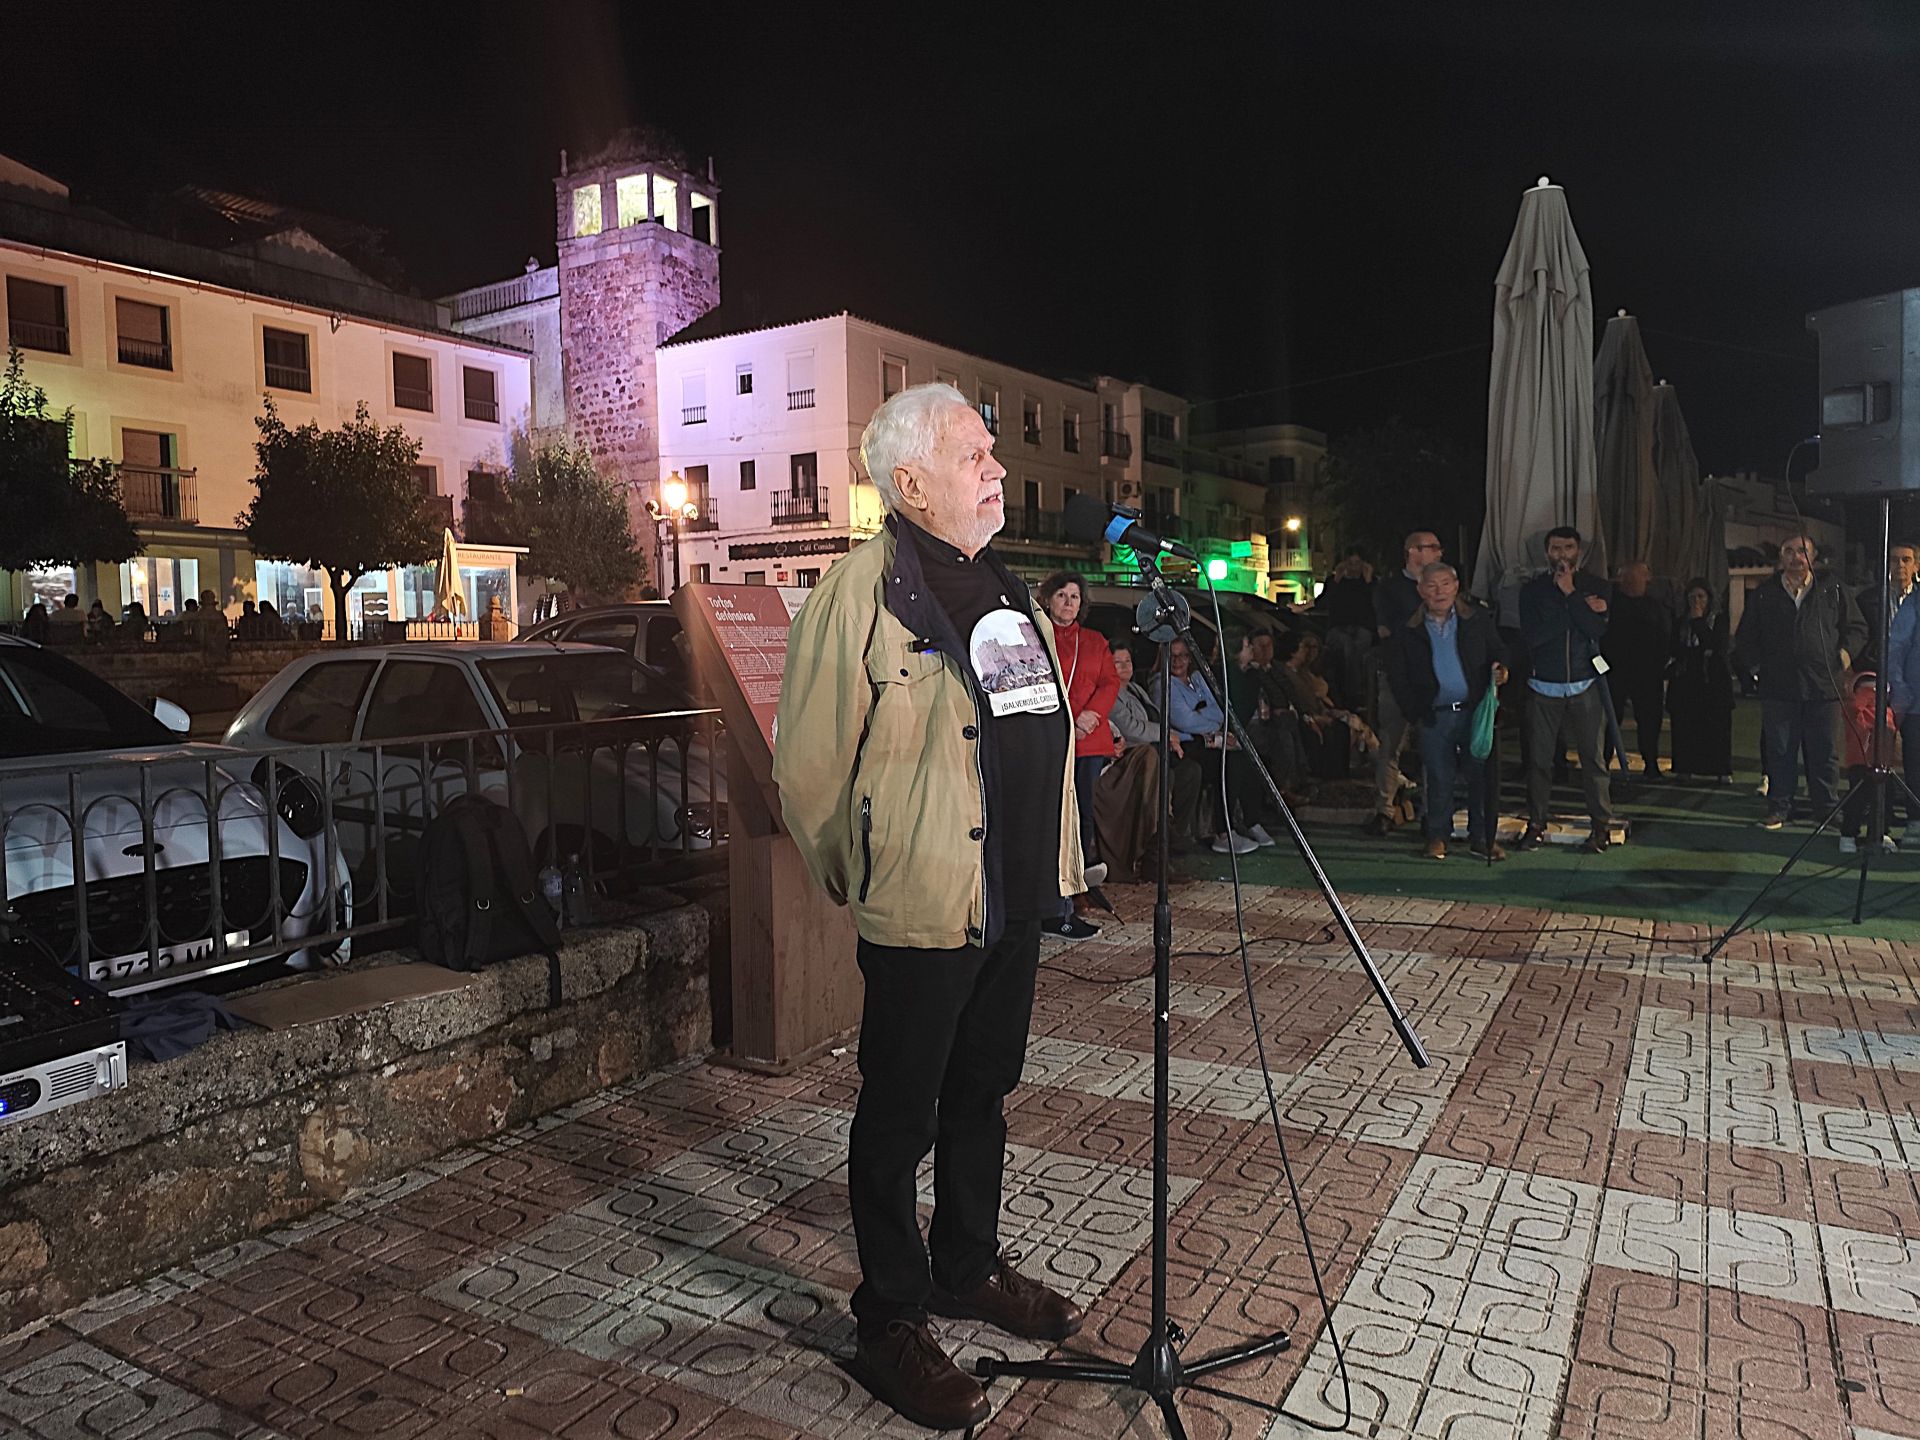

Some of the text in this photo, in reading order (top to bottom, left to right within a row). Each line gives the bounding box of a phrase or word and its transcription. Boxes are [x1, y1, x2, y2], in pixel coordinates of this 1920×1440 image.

[457, 552, 502, 561] RESTAURANTE
[707, 596, 734, 609] Torres
[715, 610, 756, 622] defensivas
